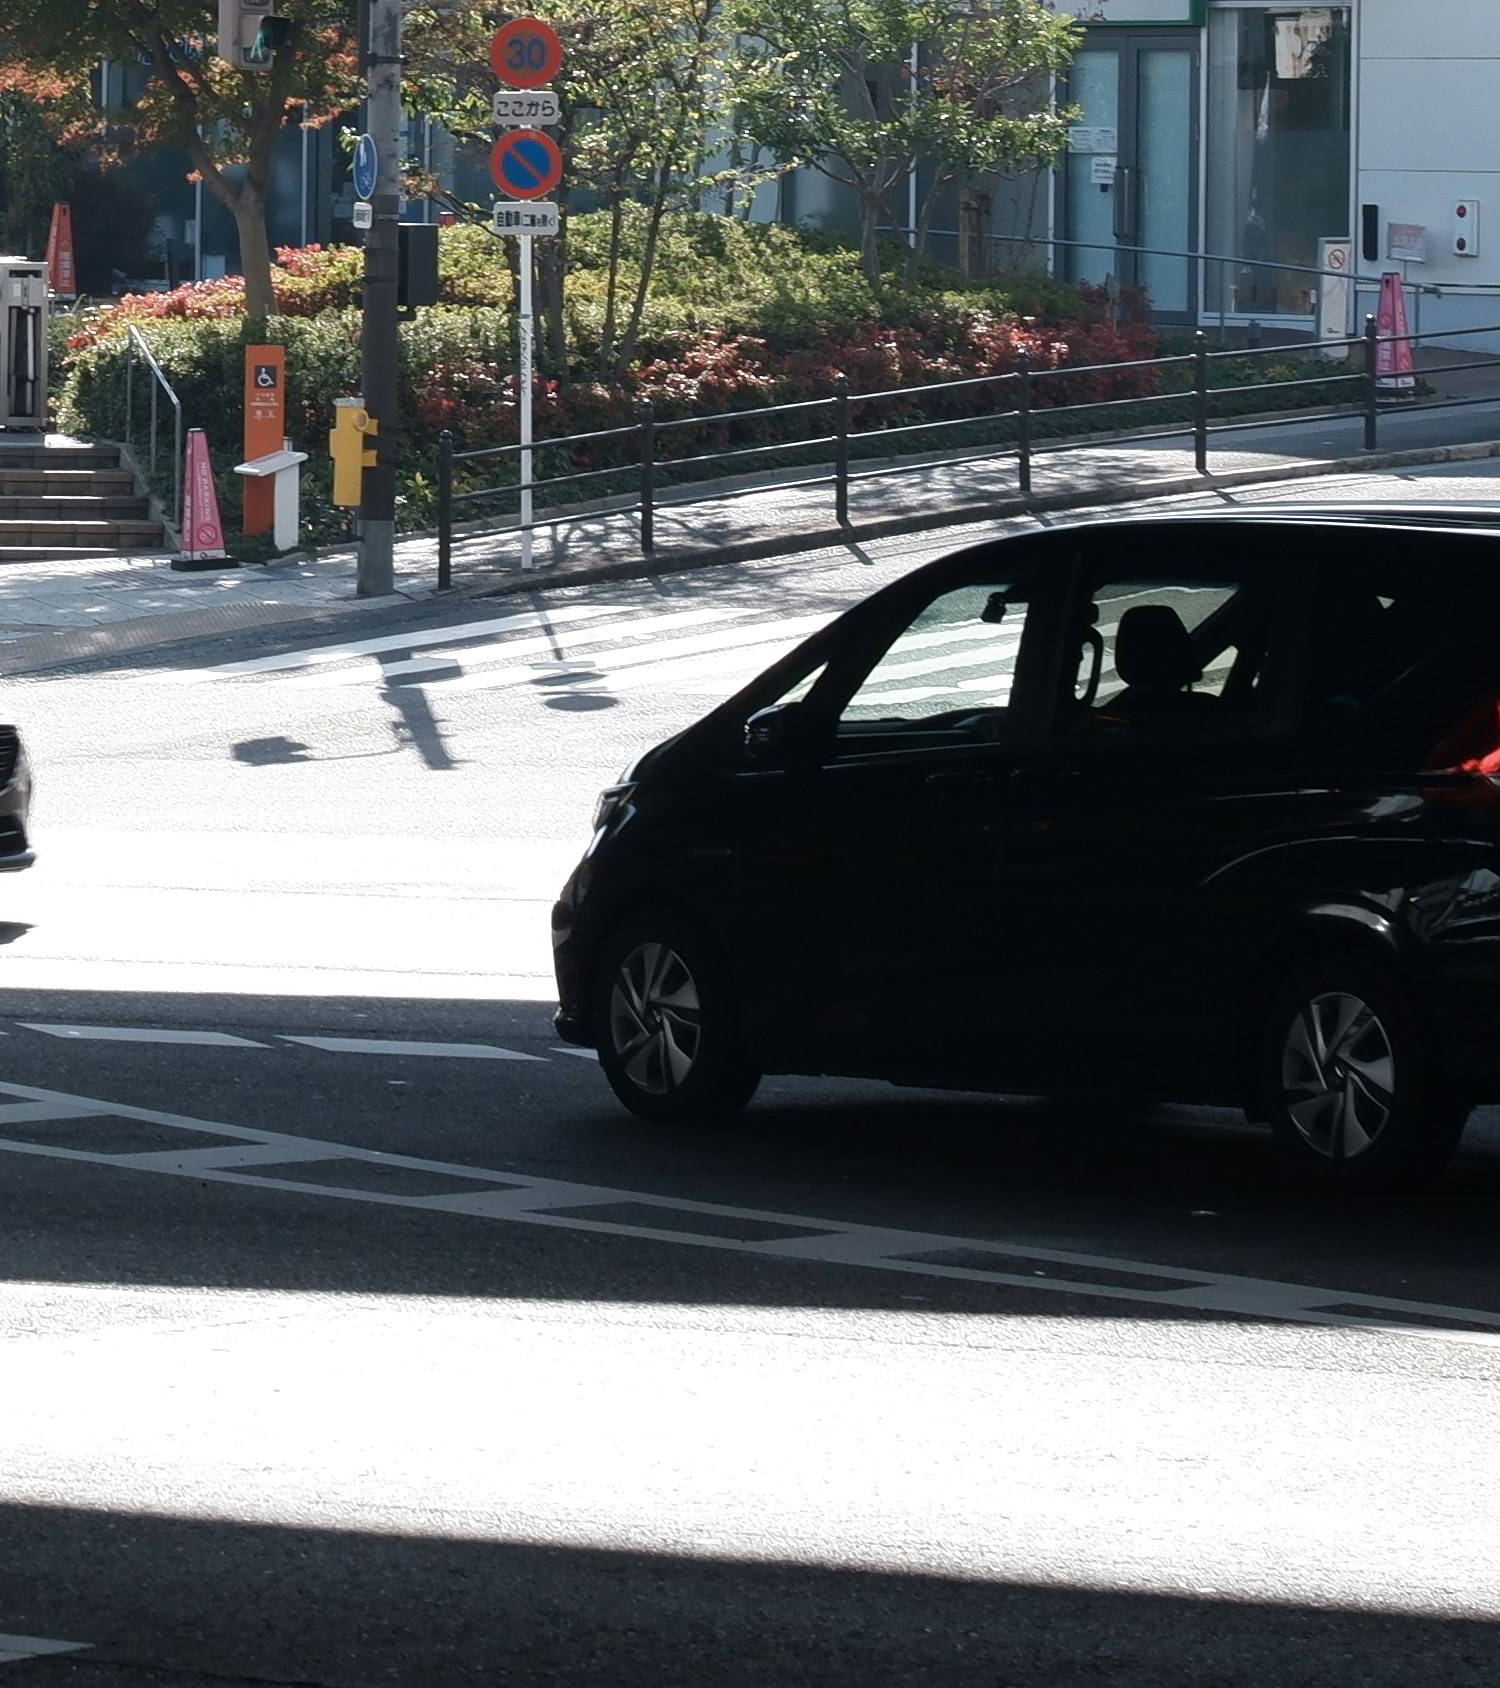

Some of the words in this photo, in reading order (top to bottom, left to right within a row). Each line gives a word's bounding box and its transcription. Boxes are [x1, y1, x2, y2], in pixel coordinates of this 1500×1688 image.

[507, 39, 548, 70] 30
[496, 100, 555, 117] ここから
